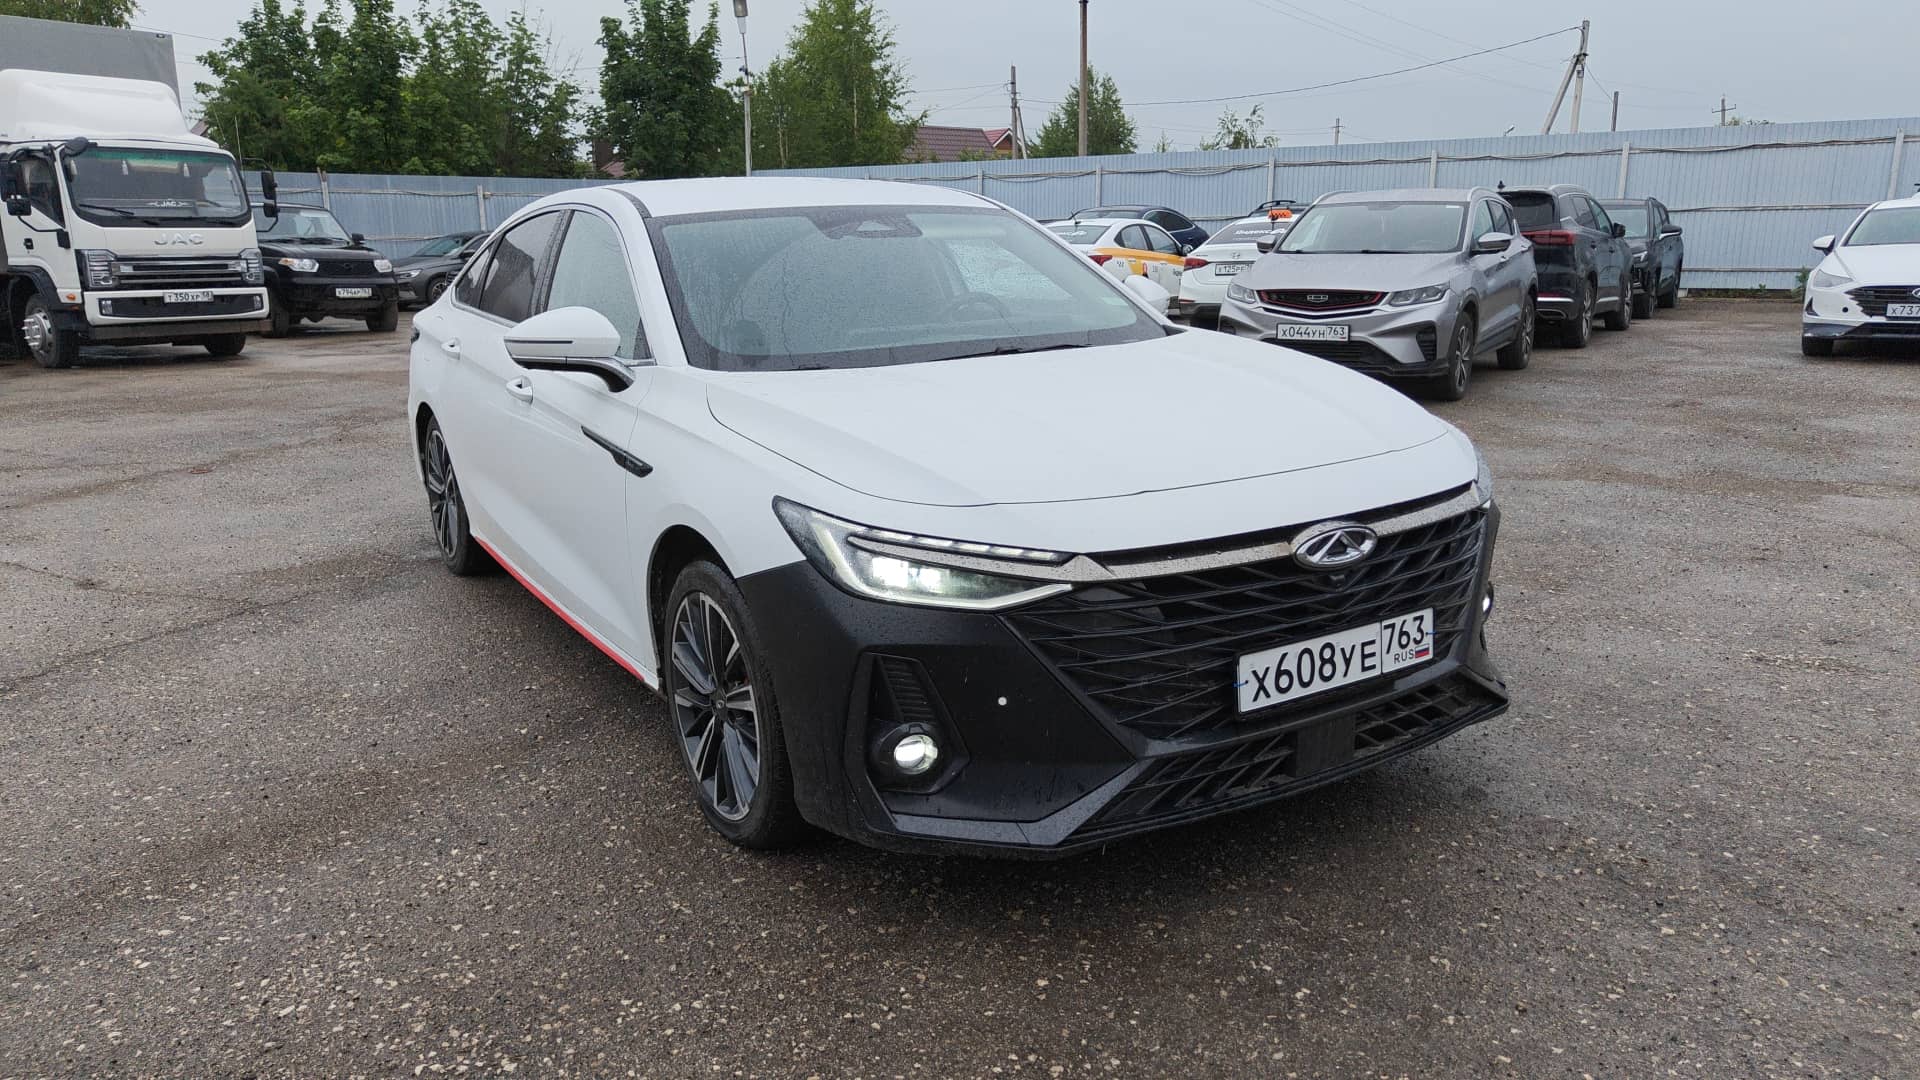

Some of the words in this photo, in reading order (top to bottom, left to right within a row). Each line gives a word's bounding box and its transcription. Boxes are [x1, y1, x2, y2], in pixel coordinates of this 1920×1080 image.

[154, 232, 204, 246] JAC
[1327, 326, 1345, 336] 763
[1383, 614, 1426, 655] 763
[1393, 649, 1415, 665] RUS
